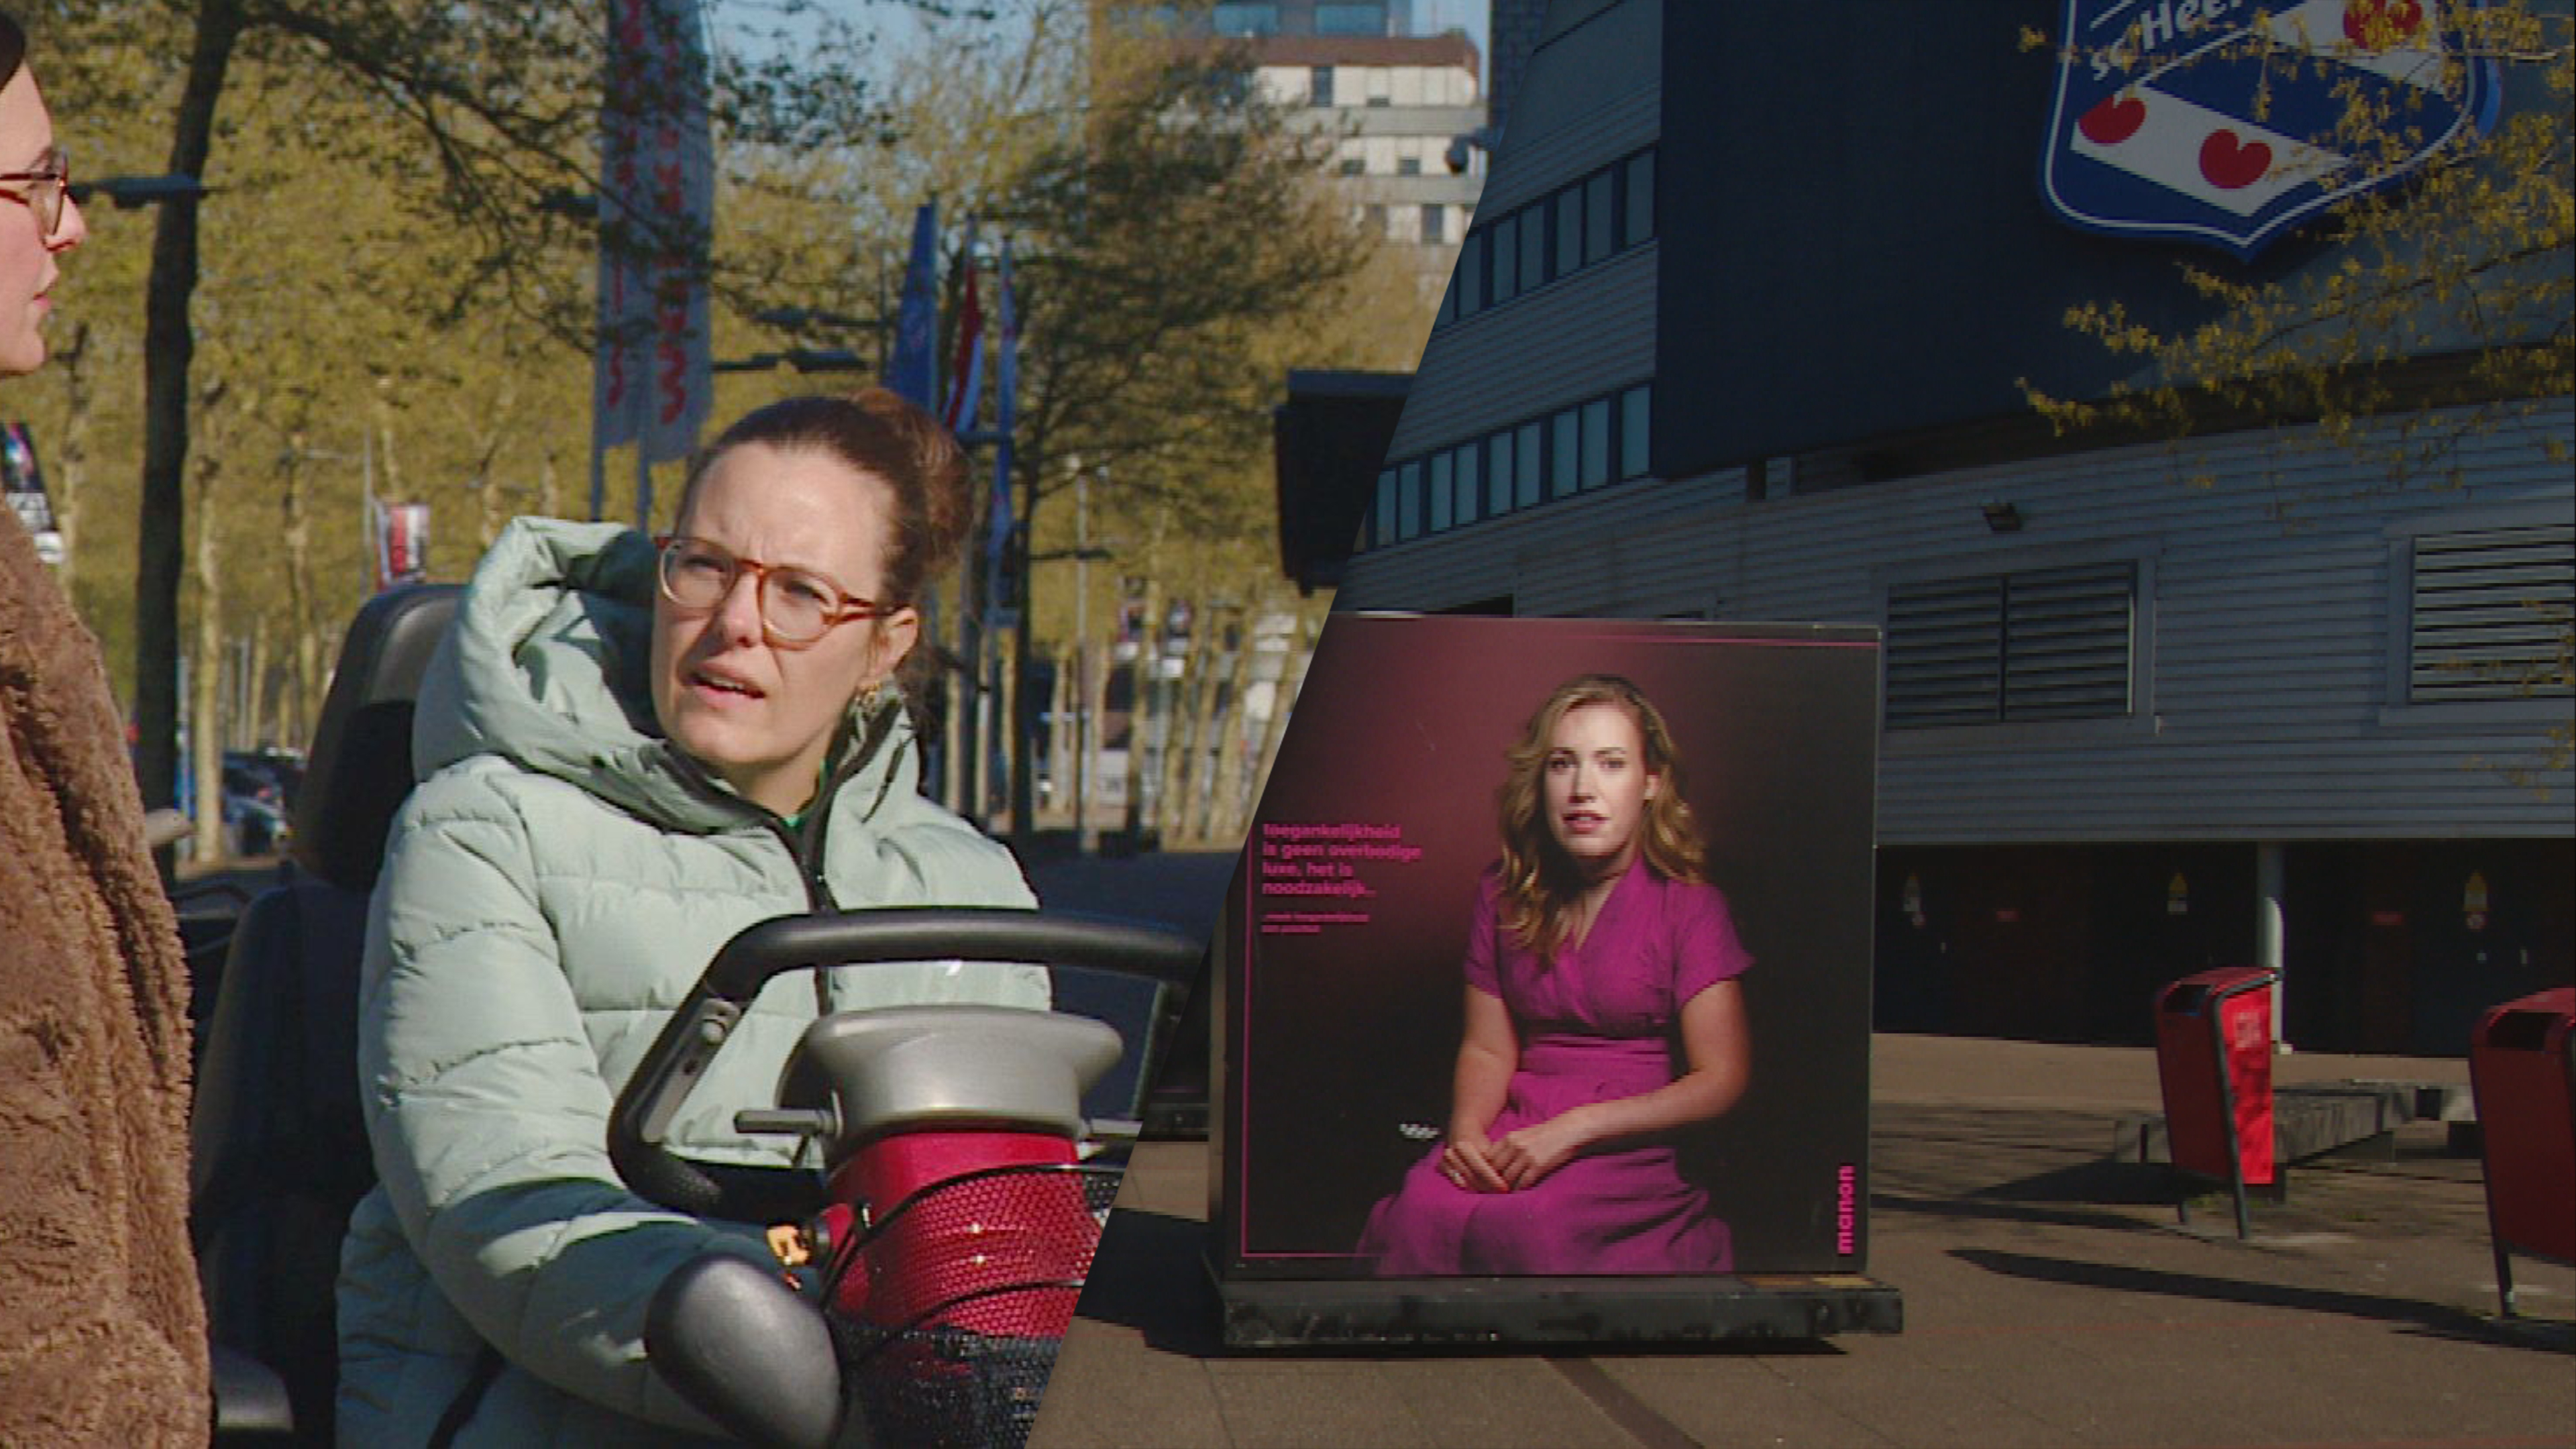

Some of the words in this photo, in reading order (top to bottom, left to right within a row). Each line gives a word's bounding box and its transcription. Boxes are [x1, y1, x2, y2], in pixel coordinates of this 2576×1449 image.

[1263, 841, 1277, 856] is
[1282, 845, 1325, 859] geen
[1328, 844, 1422, 863] overbodige
[1307, 862, 1335, 876] het
[1338, 862, 1354, 876] is
[1837, 1165, 1856, 1254] manon
